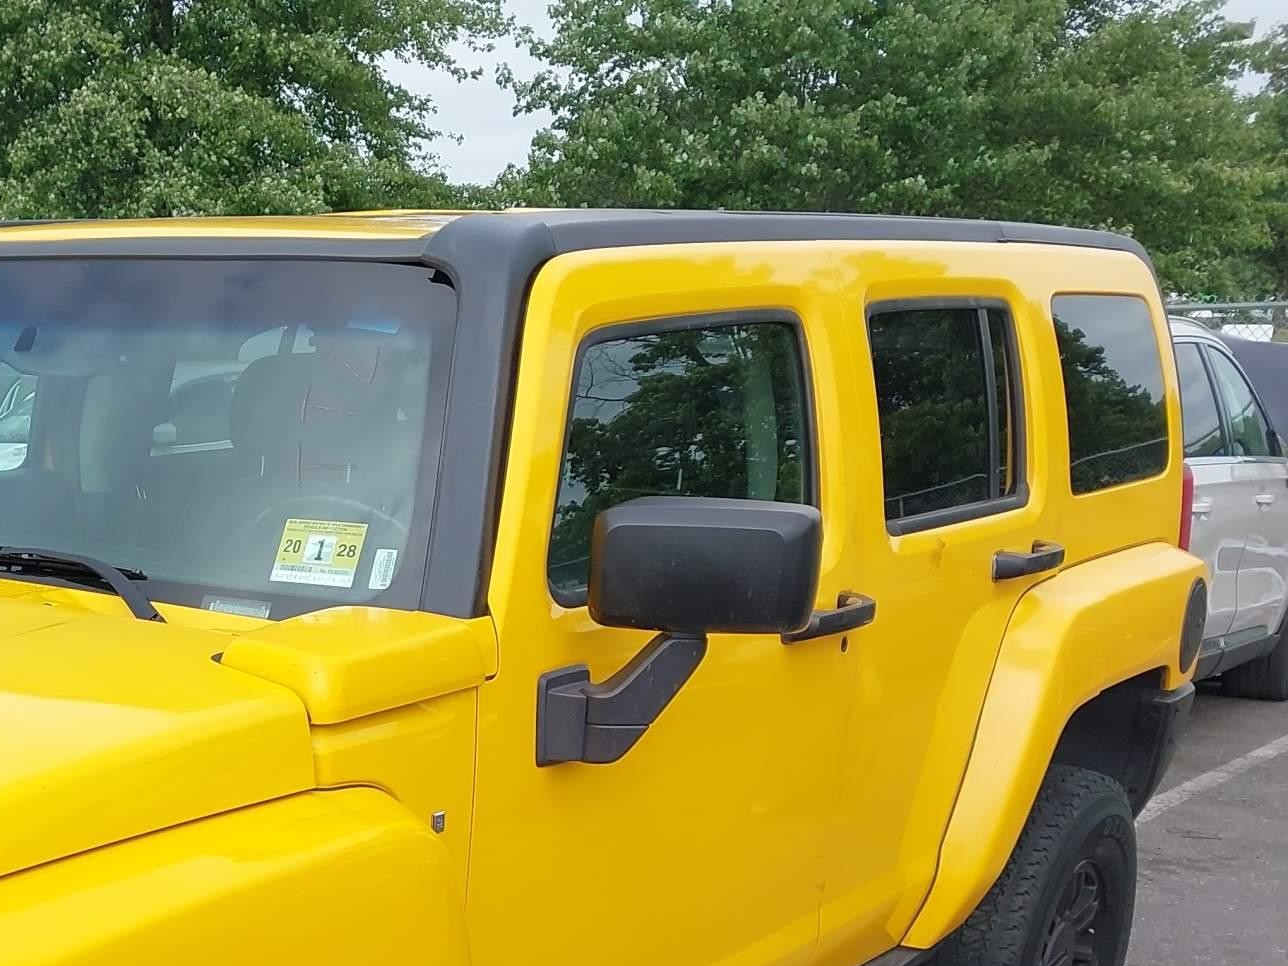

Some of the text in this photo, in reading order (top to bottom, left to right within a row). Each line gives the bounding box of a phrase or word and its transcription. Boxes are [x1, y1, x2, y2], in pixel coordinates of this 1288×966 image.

[283, 539, 357, 560] 20 1 28
